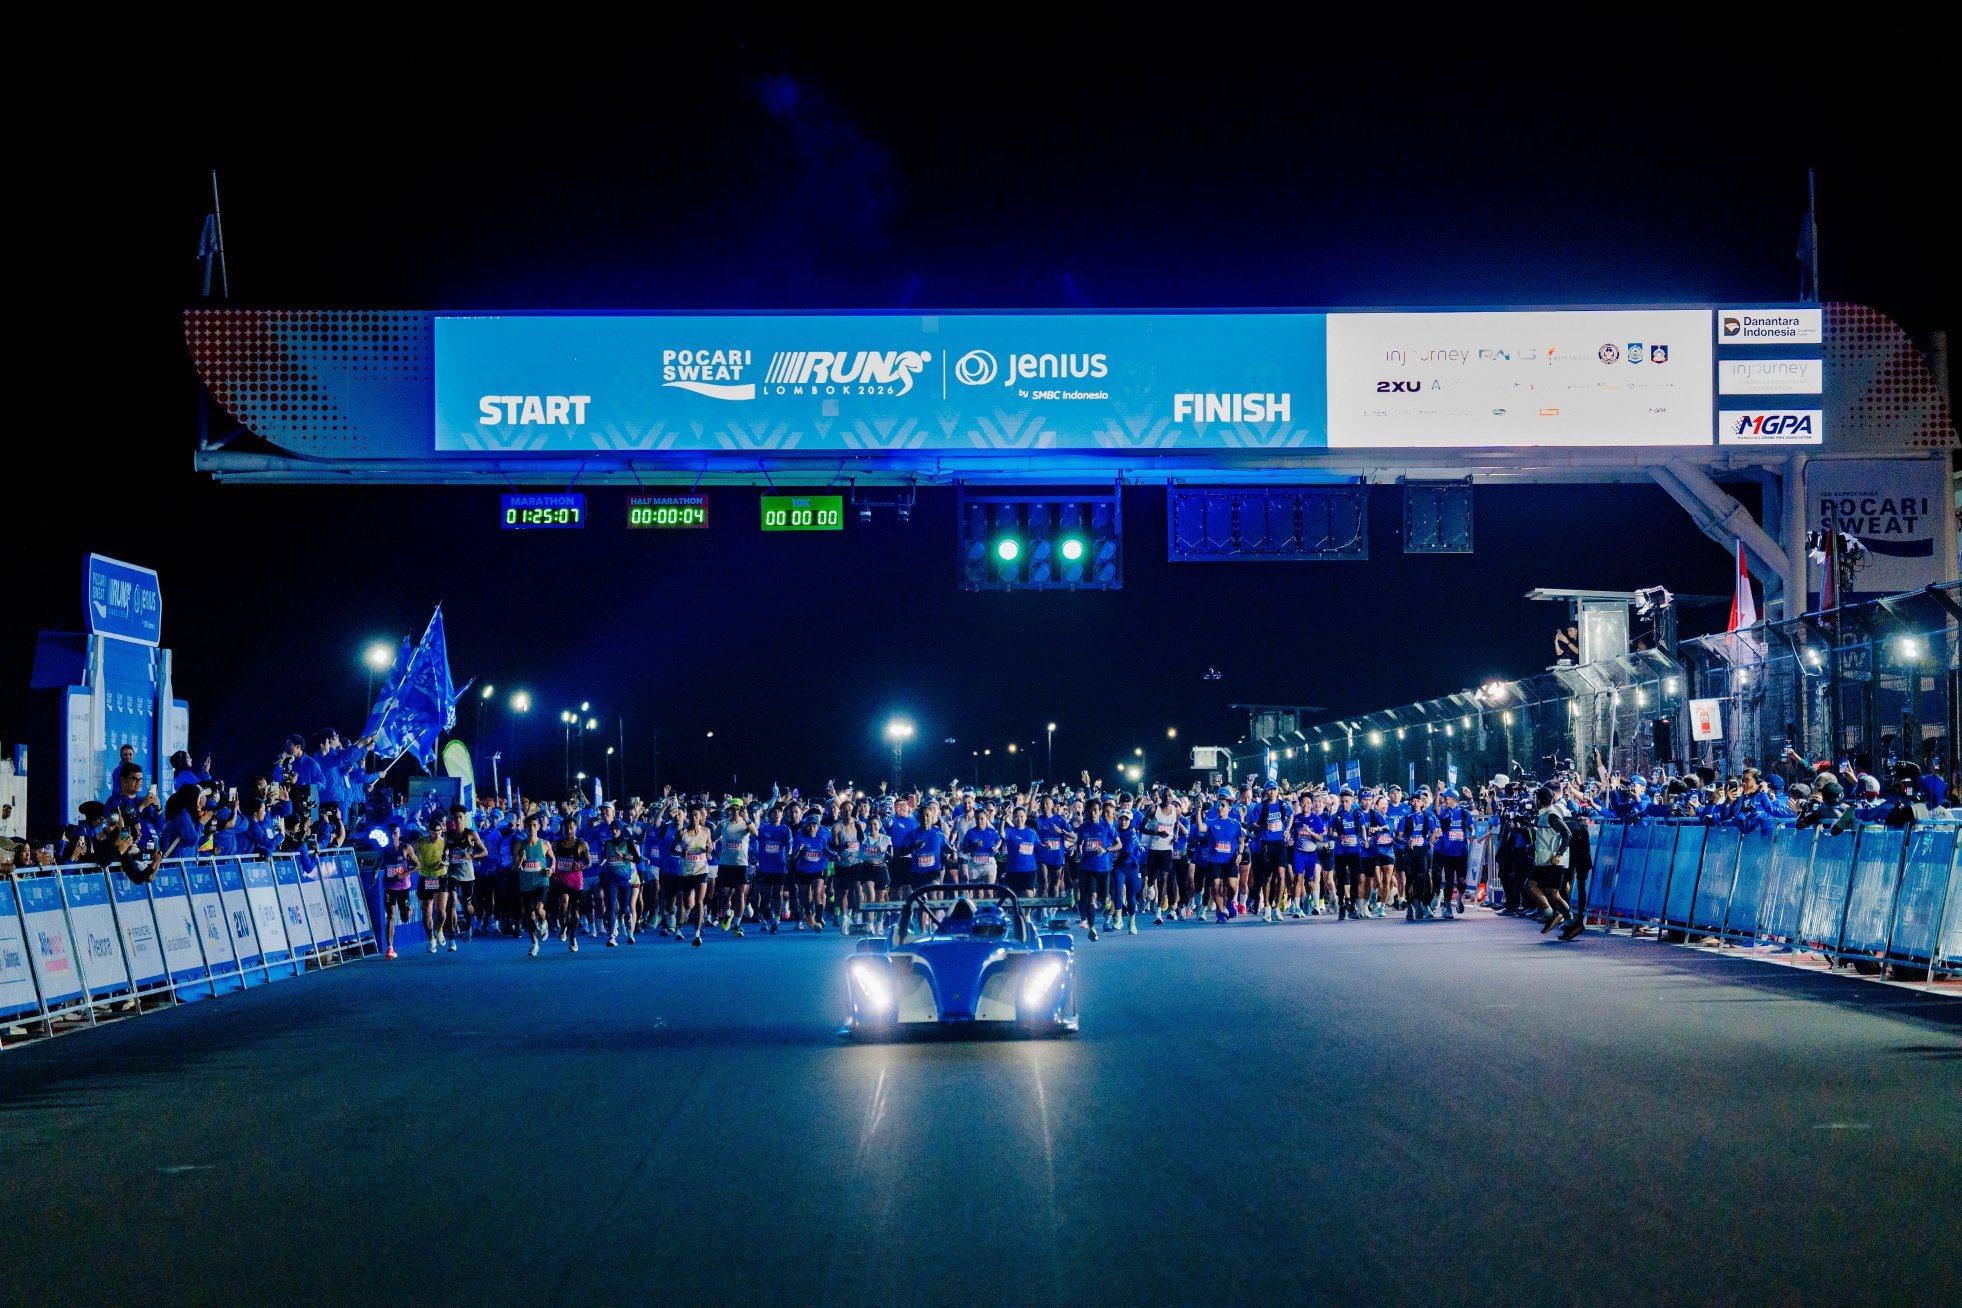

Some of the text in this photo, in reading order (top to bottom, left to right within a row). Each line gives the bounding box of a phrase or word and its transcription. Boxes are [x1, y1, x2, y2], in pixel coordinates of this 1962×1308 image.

[1743, 316, 1800, 326] Danantara
[1743, 327, 1796, 337] Indonesia
[663, 350, 751, 366] POCARI
[663, 365, 744, 381] SWEAT
[763, 386, 894, 395] LOMBOK 2026
[1376, 381, 1421, 393] 2XU
[1018, 389, 1109, 400] by SMBC Indonesia
[479, 395, 591, 425] START
[1173, 393, 1291, 423] FINISH
[510, 496, 574, 506] MARATHON
[630, 497, 703, 505] HALF MARATHON
[791, 498, 810, 508] 10K
[1821, 498, 1928, 516] POCARI
[506, 508, 580, 524] 01:25:07
[631, 509, 704, 524] 00:00:04
[1821, 516, 1919, 534] SWEAT
